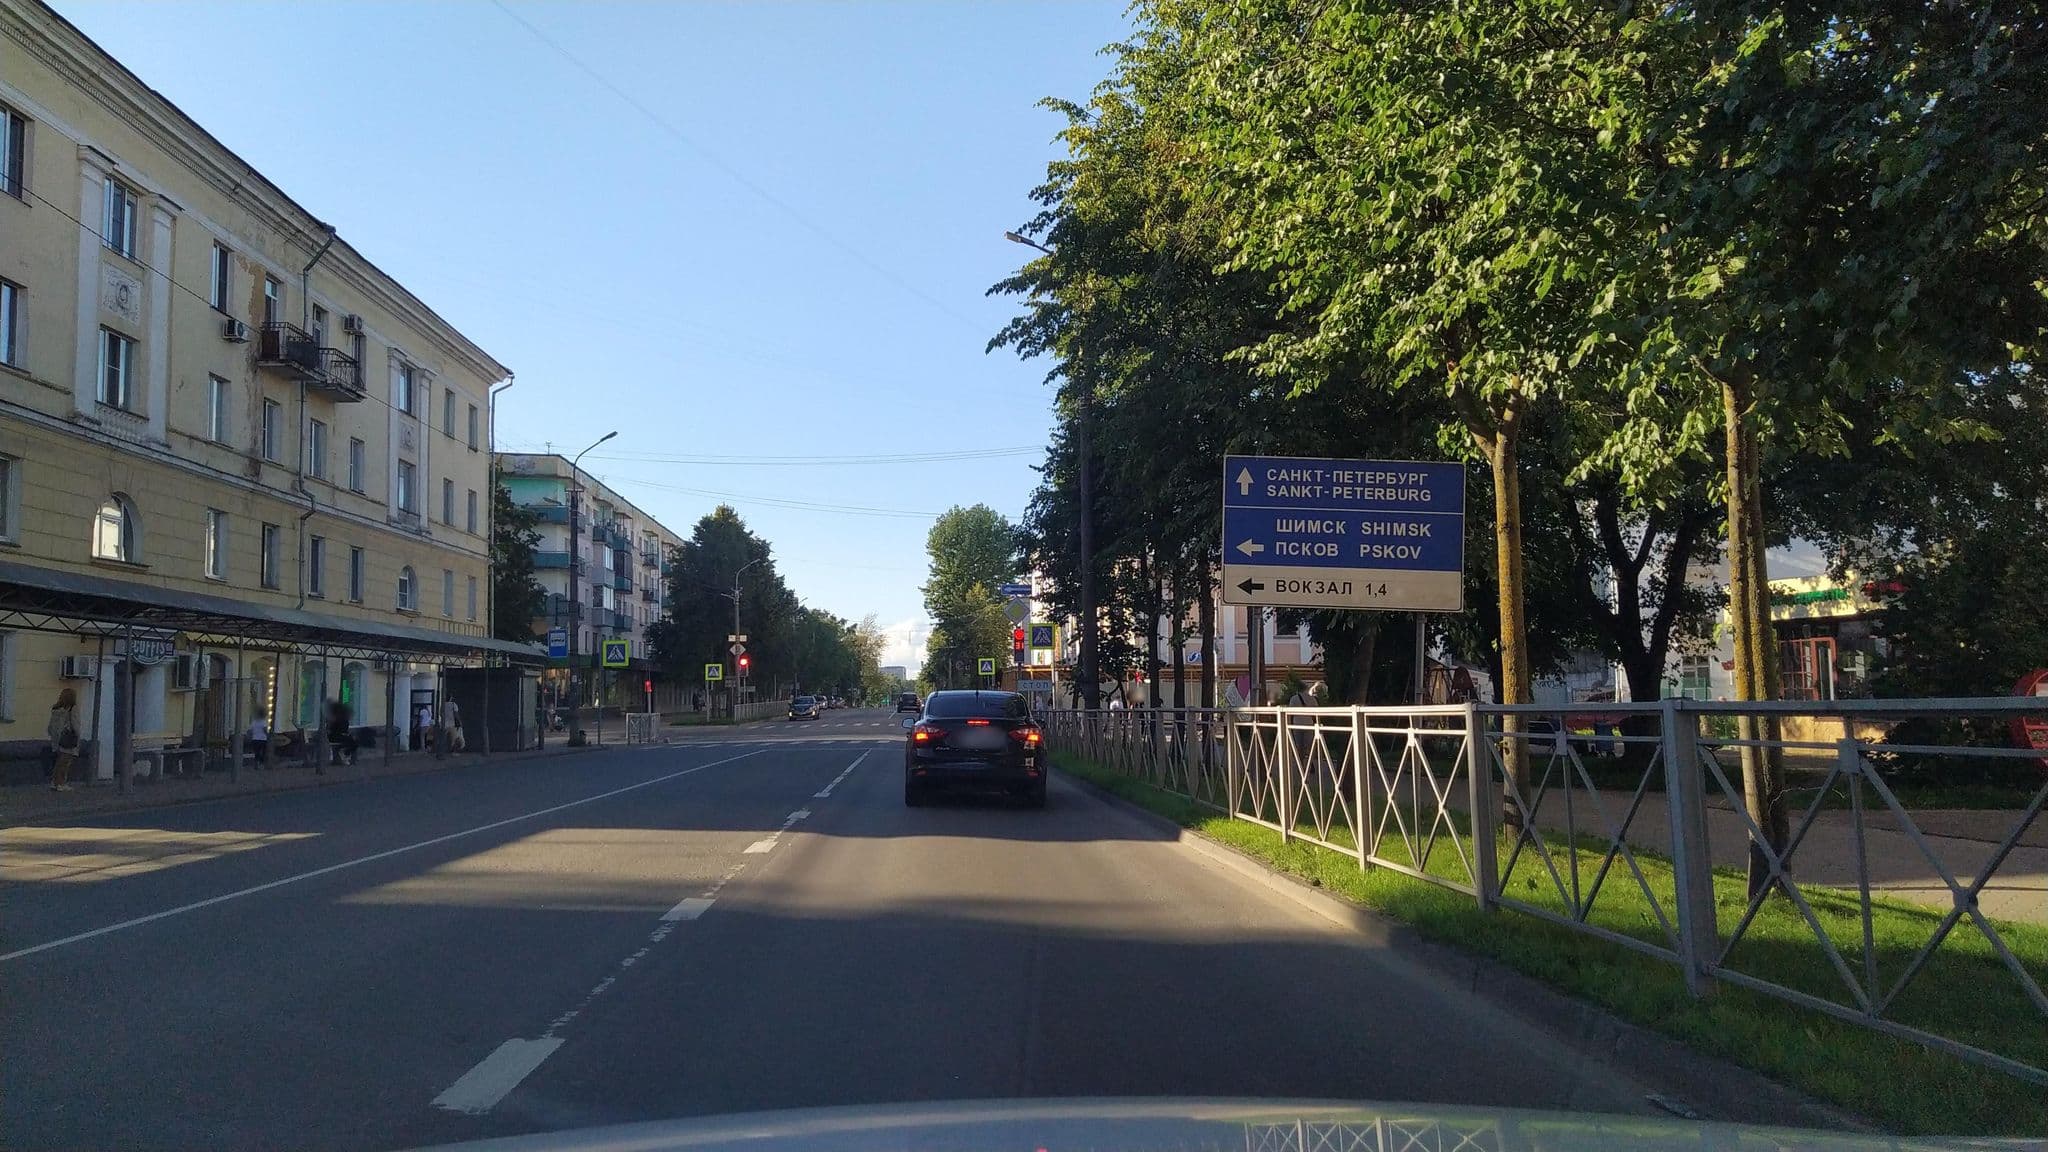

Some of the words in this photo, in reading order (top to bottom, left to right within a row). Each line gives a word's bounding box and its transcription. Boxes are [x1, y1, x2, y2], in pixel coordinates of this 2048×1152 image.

[1266, 468, 1429, 486] САНКТ-ПЕТЕРБУРГ
[1266, 485, 1432, 502] SANKT-PETERBURG
[1276, 518, 1346, 534] ШИМСК
[1361, 521, 1432, 537] SHIMSK
[1275, 541, 1339, 557] ПСКОВ
[1359, 544, 1422, 560] PSKOV
[1276, 579, 1352, 595] ВОКЗАЛ
[1365, 583, 1387, 598] 1,4
[1022, 681, 1049, 689] СТОП
